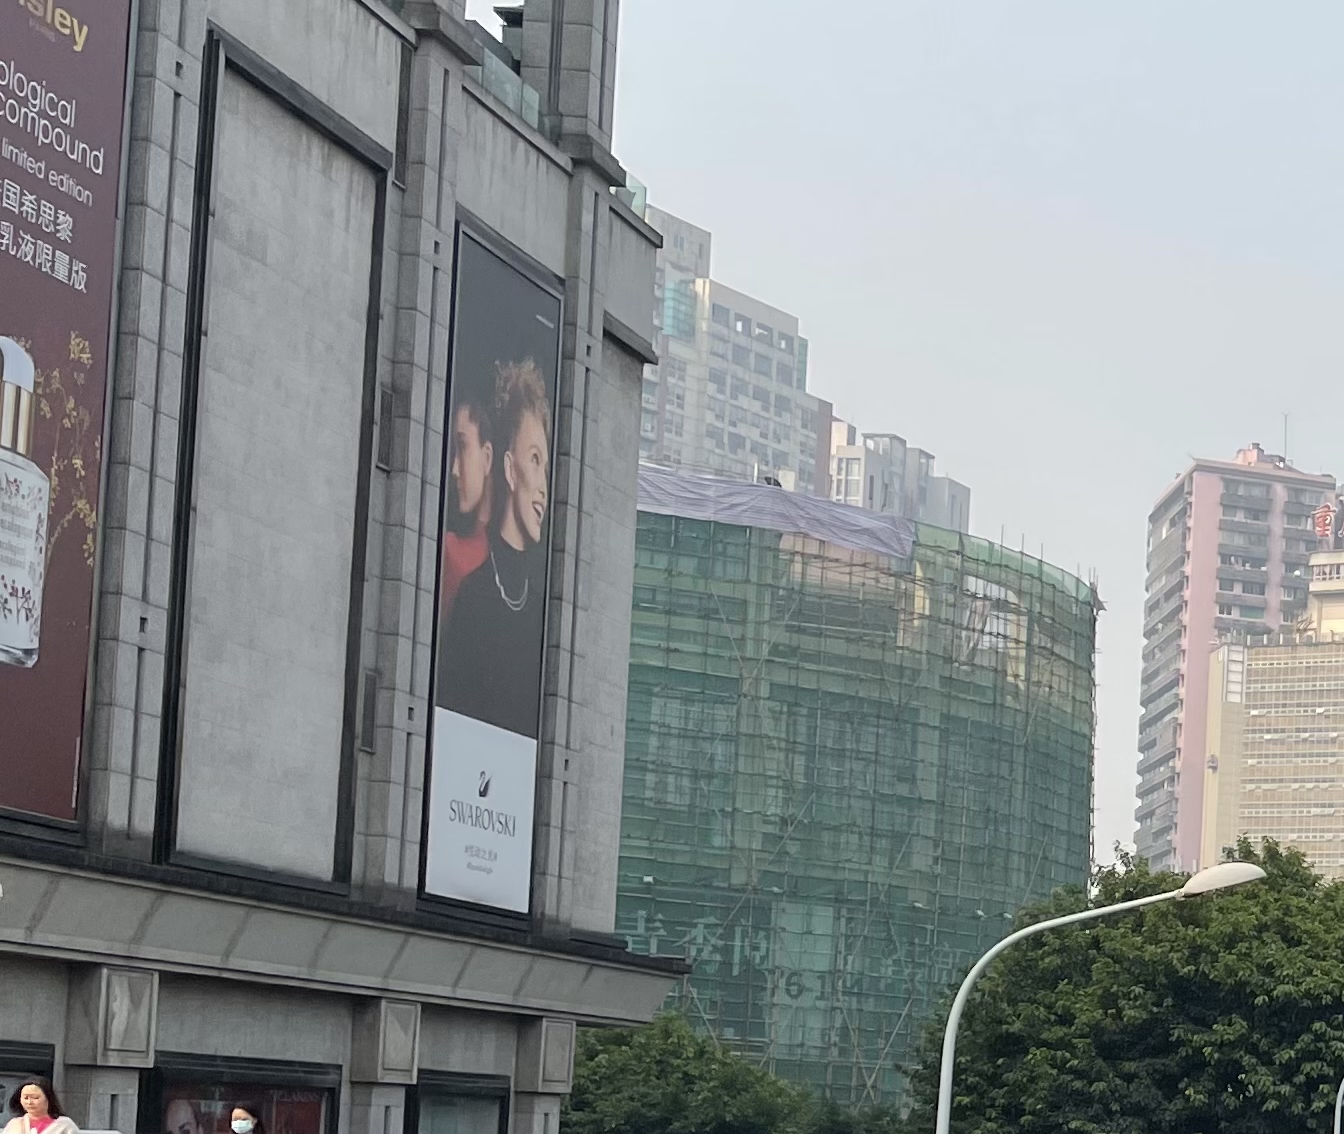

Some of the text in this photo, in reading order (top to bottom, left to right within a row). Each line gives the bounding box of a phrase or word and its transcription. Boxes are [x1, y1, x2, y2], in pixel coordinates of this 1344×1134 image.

[18, 0, 89, 52] sley
[2, 137, 93, 207] limited edition
[0, 179, 73, 243] 国希思黎
[0, 221, 88, 293] 乳液限量版
[449, 799, 516, 837] SWAROVSKI
